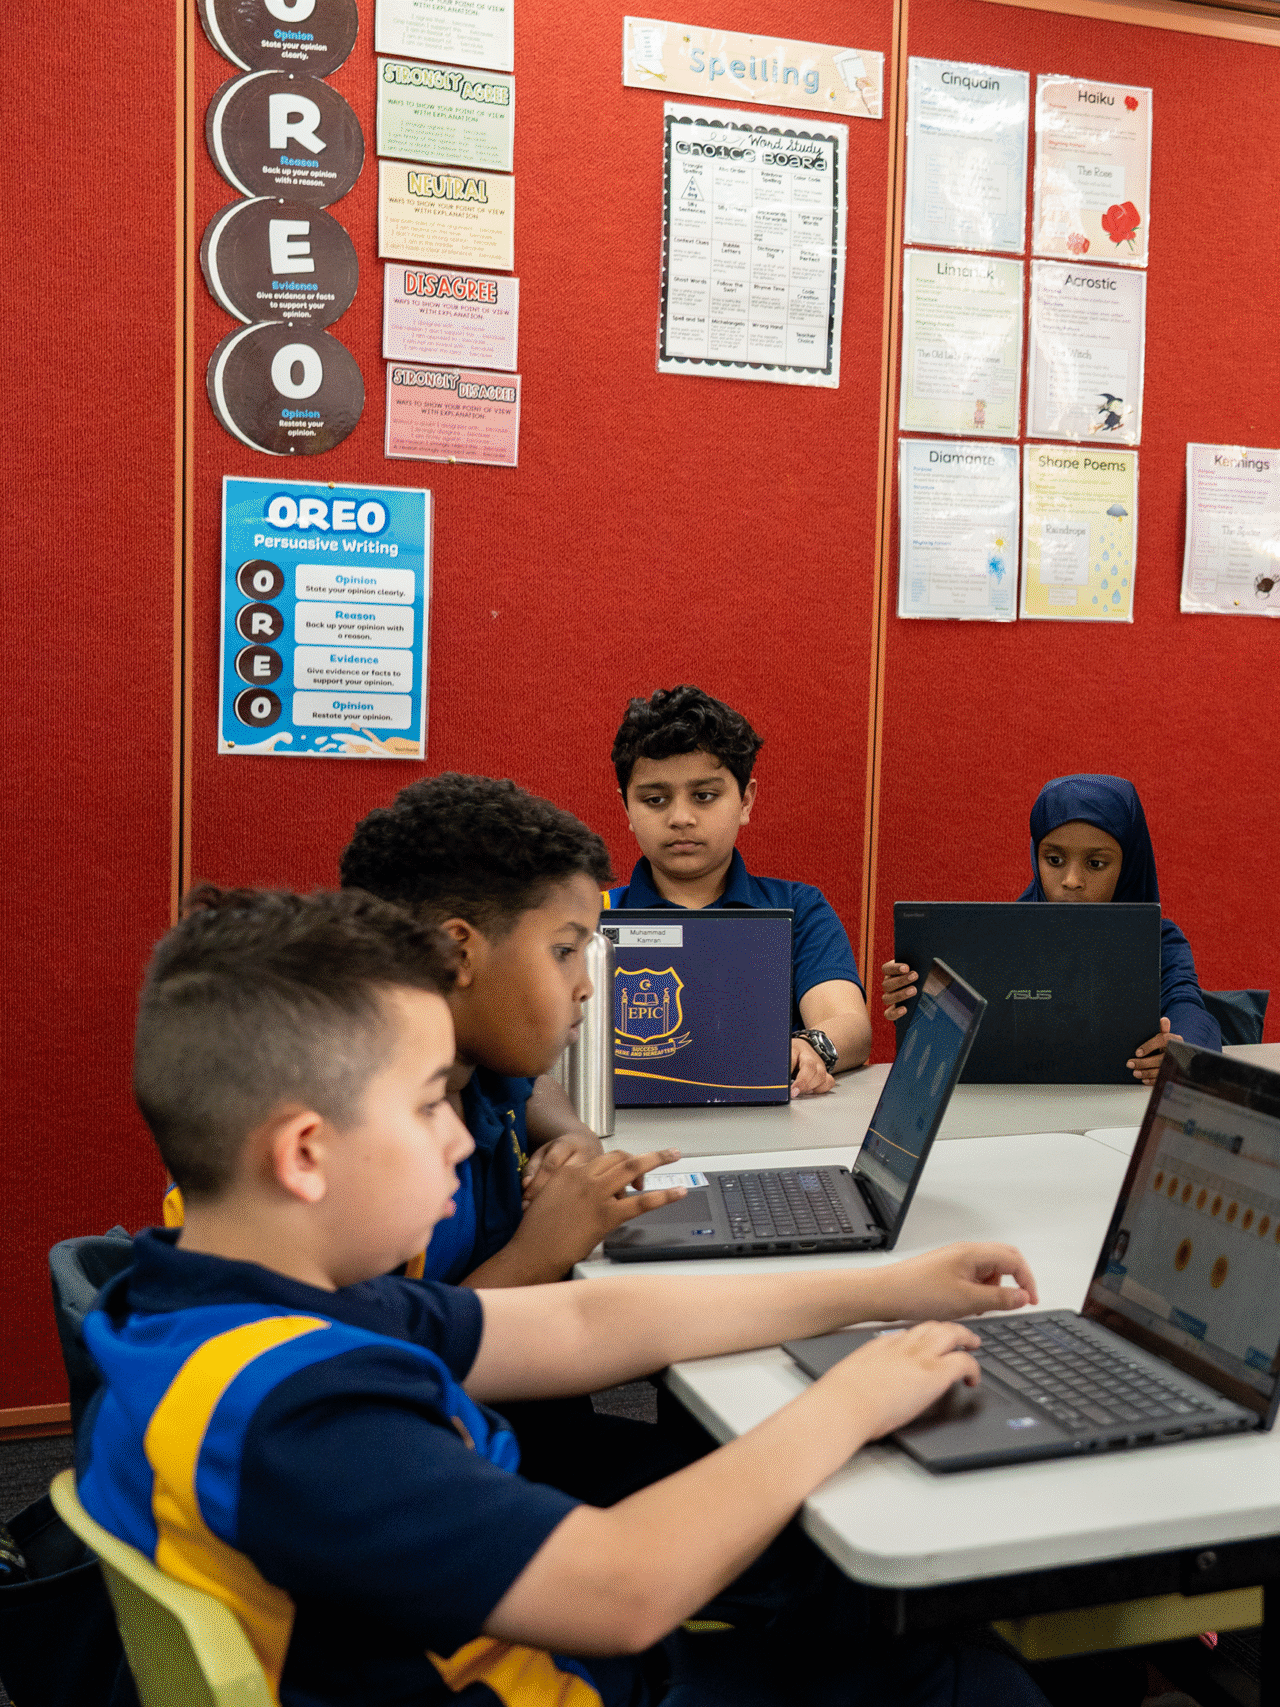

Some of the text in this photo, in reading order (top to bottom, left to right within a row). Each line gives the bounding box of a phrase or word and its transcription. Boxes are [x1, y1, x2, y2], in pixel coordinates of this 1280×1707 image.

[274, 29, 314, 41] Opinion
[261, 39, 328, 51] State your opinion
[690, 48, 820, 94] Spelling
[384, 63, 510, 106] STRONGLY AGREE
[941, 72, 1000, 91] Cinquain
[1078, 90, 1115, 106] Haiku
[269, 93, 327, 154] R
[749, 134, 823, 157] Word Study
[280, 155, 319, 168] Reason
[262, 165, 337, 179] Back up your opinion
[1078, 165, 1112, 178] The Rose
[408, 171, 488, 203] NEUTRAL
[268, 218, 315, 274] E
[272, 280, 319, 291] Evidence
[404, 270, 497, 304] DISAGREE
[1065, 274, 1117, 290] Acrostic
[256, 291, 273, 300] Give
[274, 292, 306, 300] evidence
[316, 292, 335, 301] facts
[269, 301, 278, 309] to
[308, 302, 325, 310] your
[271, 343, 323, 400] O
[392, 368, 516, 403] STRONGLY DISAGREE
[281, 408, 320, 420] Opinion
[278, 419, 325, 429] Restate your
[930, 451, 995, 466] Diamante
[1039, 456, 1126, 471] Shape Poems
[267, 496, 386, 534] OREO
[1046, 525, 1086, 536] Raindrops
[254, 533, 399, 558] Persuasive Writing
[253, 570, 274, 592] O
[335, 575, 377, 585] Opinion
[306, 585, 406, 597] State your opinion clearly.
[335, 611, 376, 620] Reason
[252, 612, 274, 635] R
[306, 621, 325, 629] Back
[357, 623, 385, 632] opinion
[254, 655, 271, 676] E
[330, 654, 379, 664] Evidence
[307, 667, 324, 675] Give
[325, 668, 360, 676] evidence
[313, 677, 343, 686] support
[364, 678, 394, 686] opinion.
[250, 696, 271, 719] O
[332, 701, 374, 711] Opinion
[362, 713, 393, 721] opinion.
[1005, 990, 1052, 1000] ASUS
[628, 1007, 664, 1019] EPIC
